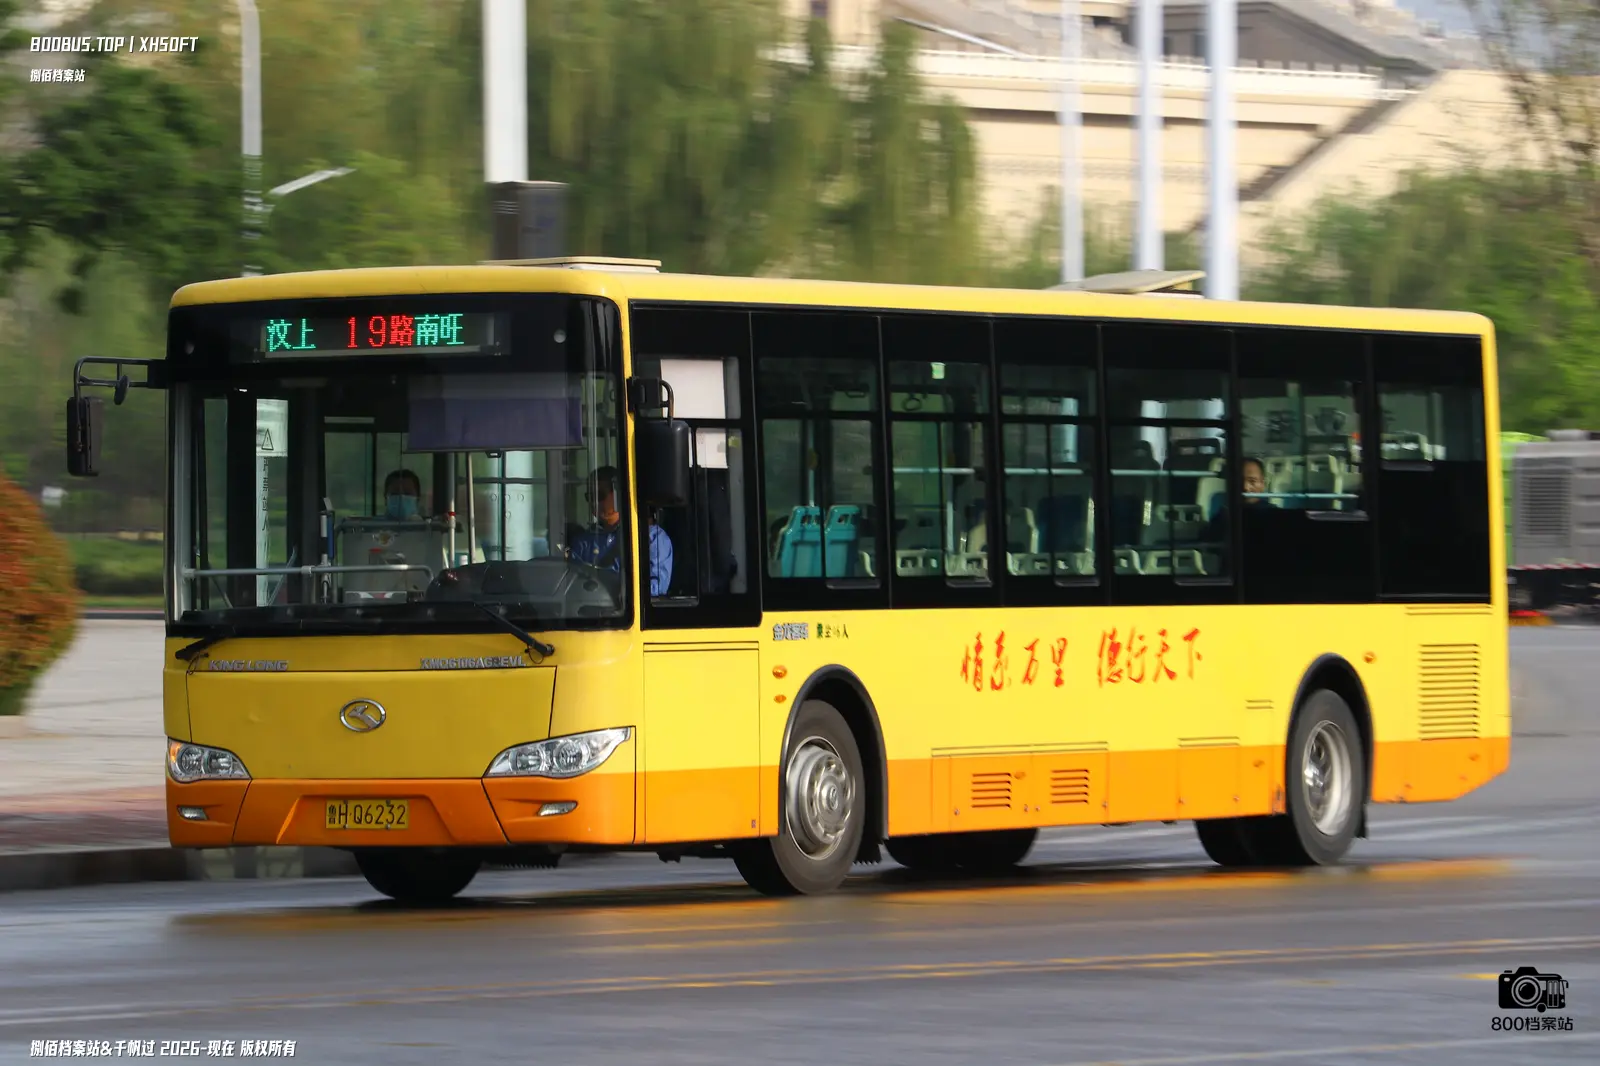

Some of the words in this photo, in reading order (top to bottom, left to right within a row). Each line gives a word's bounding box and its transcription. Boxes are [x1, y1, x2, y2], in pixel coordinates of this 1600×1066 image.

[266, 318, 317, 352] 汶上
[208, 660, 246, 672] KING
[247, 660, 289, 672] LONG
